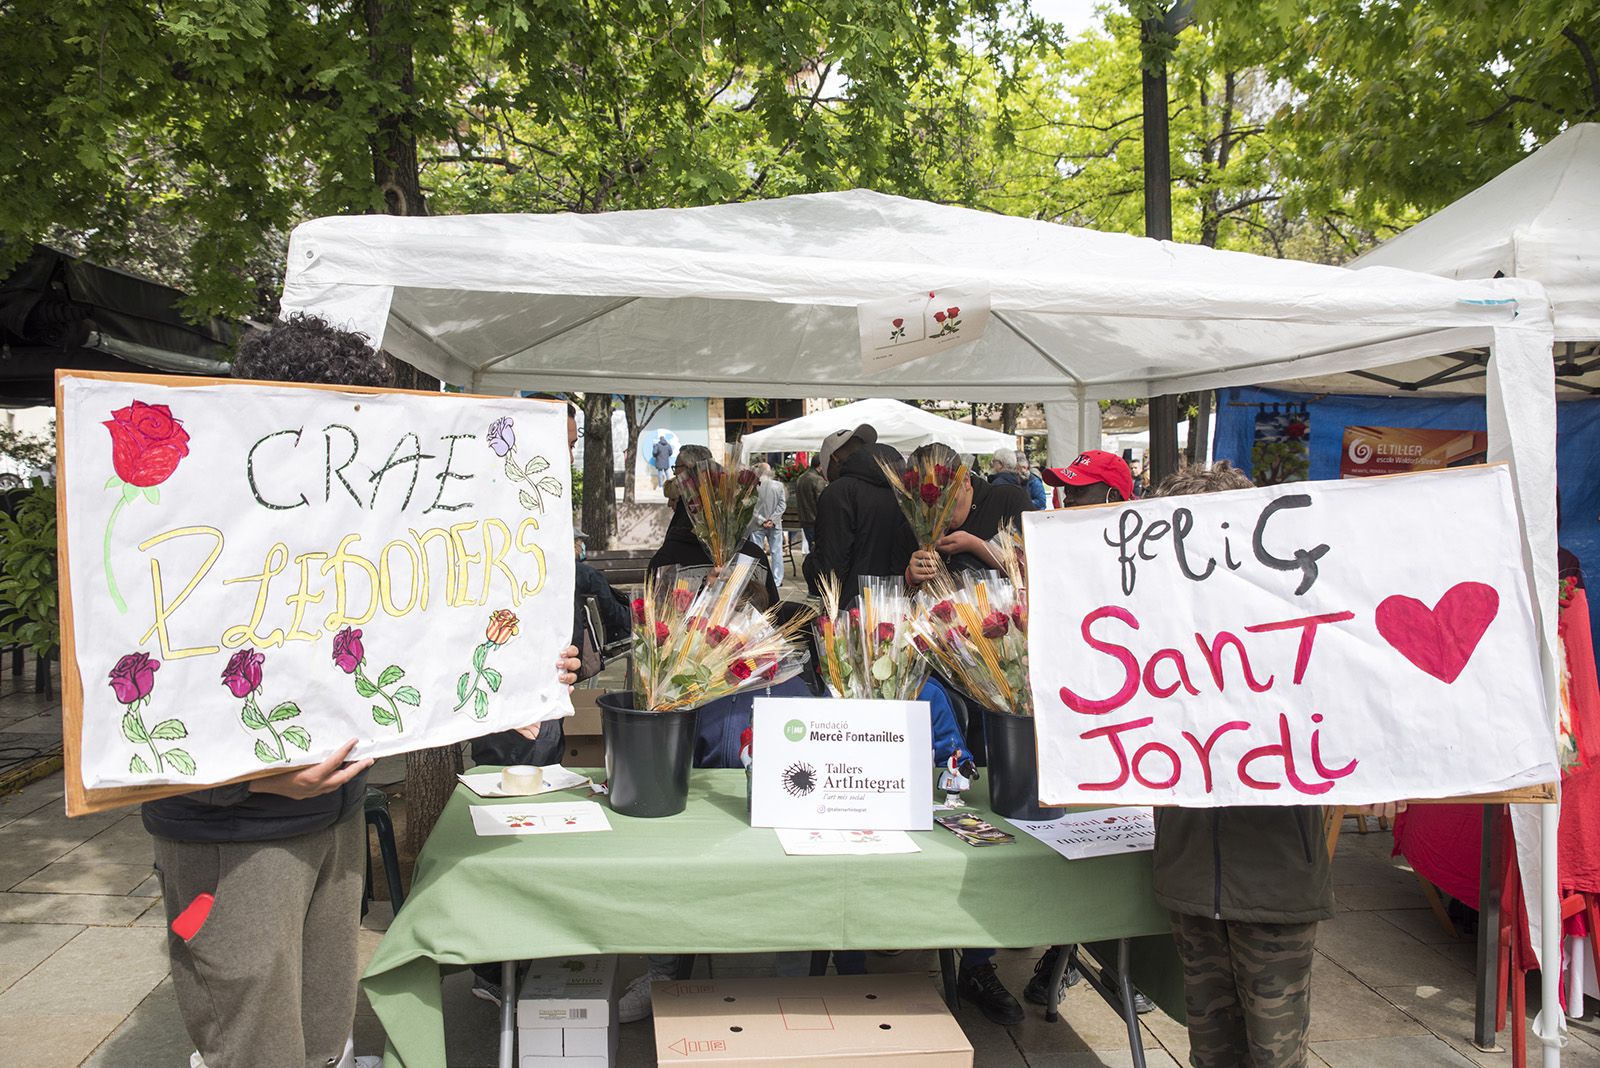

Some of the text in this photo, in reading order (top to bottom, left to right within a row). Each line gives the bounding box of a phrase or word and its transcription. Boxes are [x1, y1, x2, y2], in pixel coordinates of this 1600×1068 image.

[247, 423, 477, 514] CRAE
[810, 720, 849, 730] Fundació
[809, 730, 905, 743] Mercè Fontanilles
[1077, 712, 1360, 795] Jordi
[824, 763, 863, 774] Tallers
[823, 775, 905, 793] ArtIntegrat
